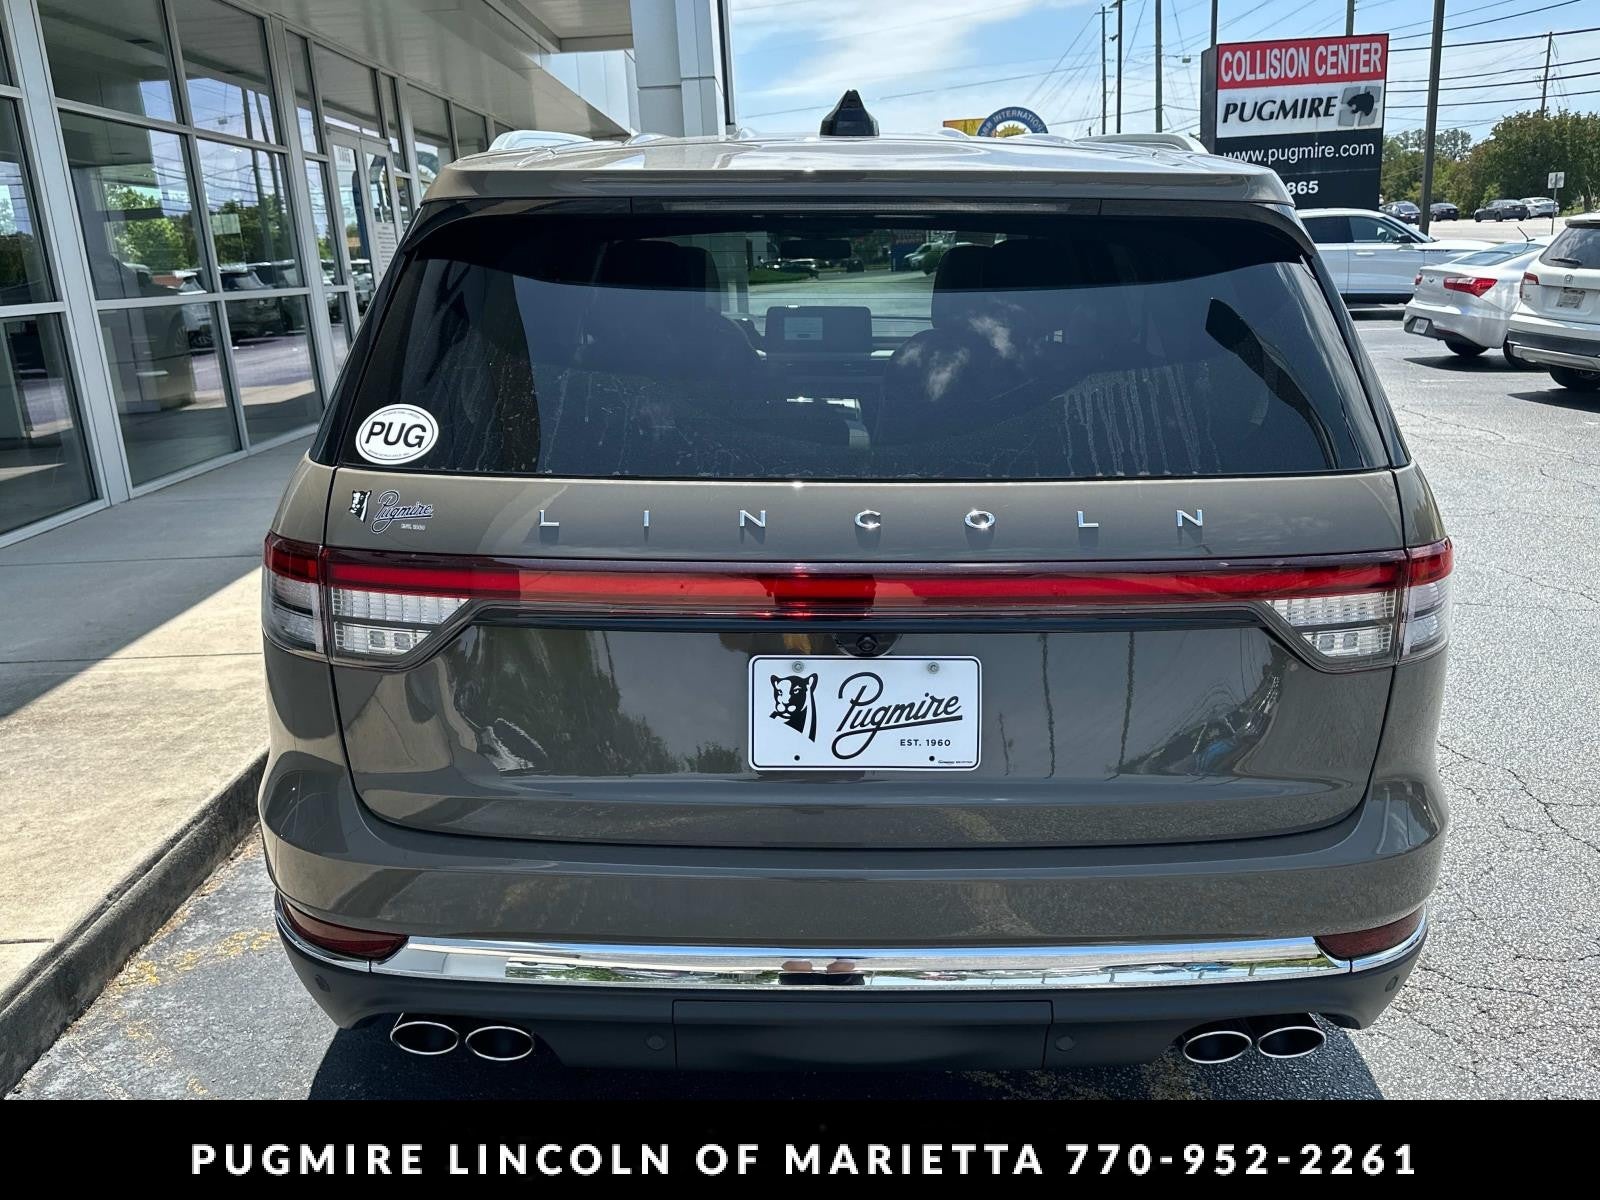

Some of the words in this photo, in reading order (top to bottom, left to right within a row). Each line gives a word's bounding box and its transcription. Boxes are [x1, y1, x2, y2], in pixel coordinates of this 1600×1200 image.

[1220, 46, 1310, 82] COLLISION
[1314, 42, 1382, 77] CENTER
[1222, 96, 1338, 124] PUGMIRE
[364, 421, 427, 448] PUG
[371, 489, 434, 534] Pugmire
[539, 508, 1203, 529] LINCOLN
[831, 671, 963, 760] Pugmire
[900, 738, 922, 747] EST.
[925, 738, 951, 747] 1960
